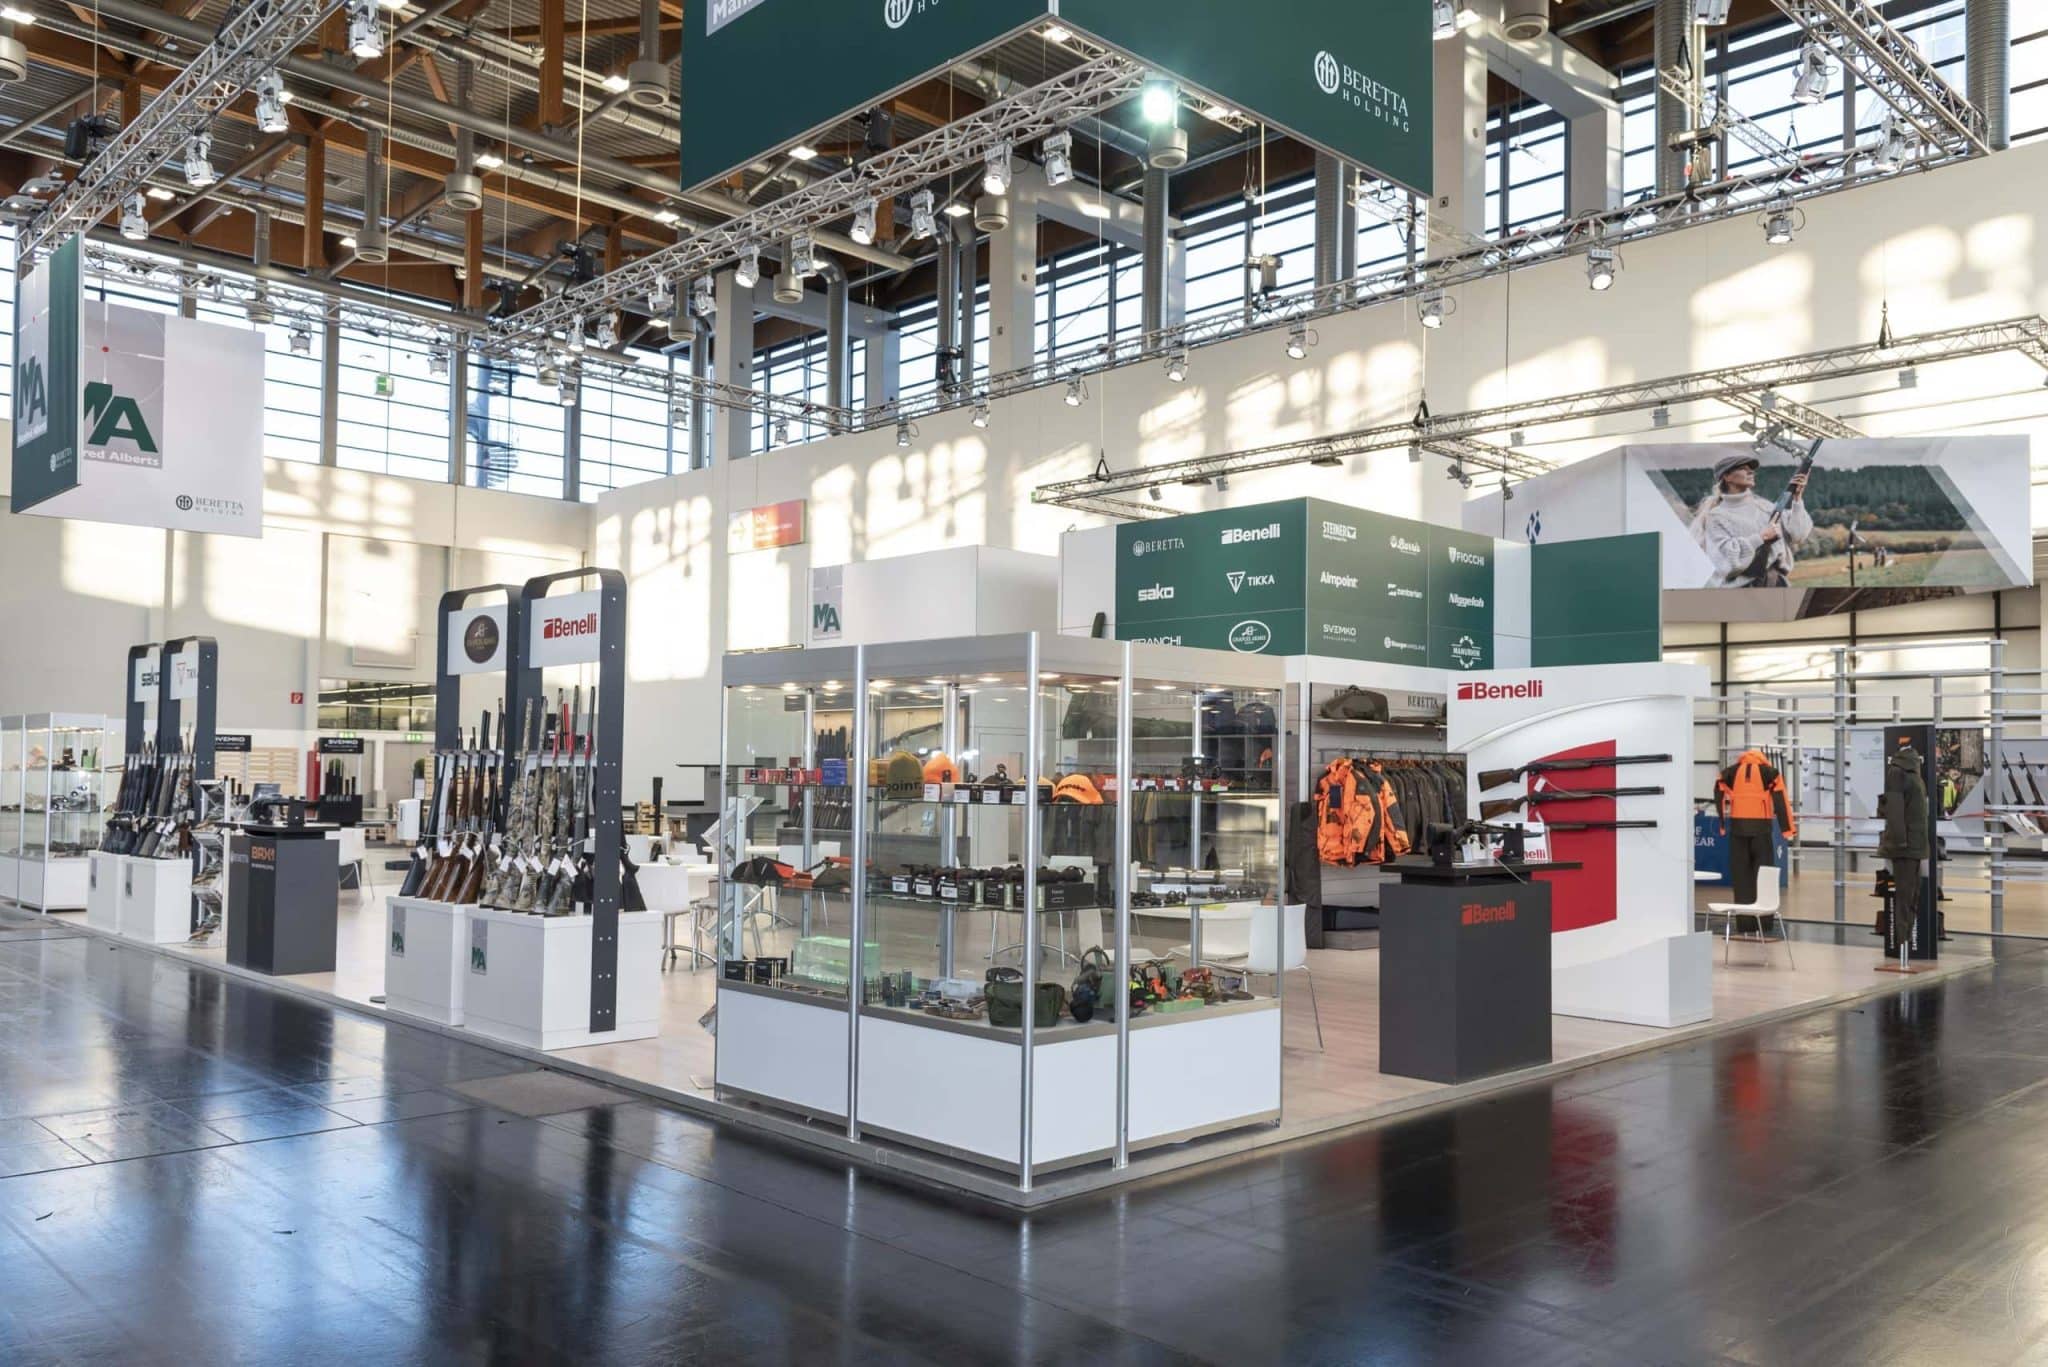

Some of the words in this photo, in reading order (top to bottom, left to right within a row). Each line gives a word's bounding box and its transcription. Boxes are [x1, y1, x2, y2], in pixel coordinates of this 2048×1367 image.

[1343, 64, 1408, 117] BERETTA
[1343, 88, 1409, 132] HOLDING
[19, 356, 47, 425] MA
[109, 451, 159, 466] Alberts
[195, 497, 244, 511] BERETTA
[1233, 523, 1281, 543] Benelli
[1145, 538, 1184, 553] BERETTA
[1456, 551, 1485, 567] FIOCCHI
[1247, 575, 1275, 587] TIKKA
[1320, 571, 1358, 589] Aimpoint
[1137, 583, 1174, 602] sako
[554, 613, 597, 638] Benelli
[813, 603, 840, 632] MA
[1474, 680, 1543, 699] Benelli
[1408, 695, 1439, 709] BERETTA
[1474, 901, 1515, 923] Benelli
[392, 931, 404, 953] MA
[471, 946, 486, 970] MA
